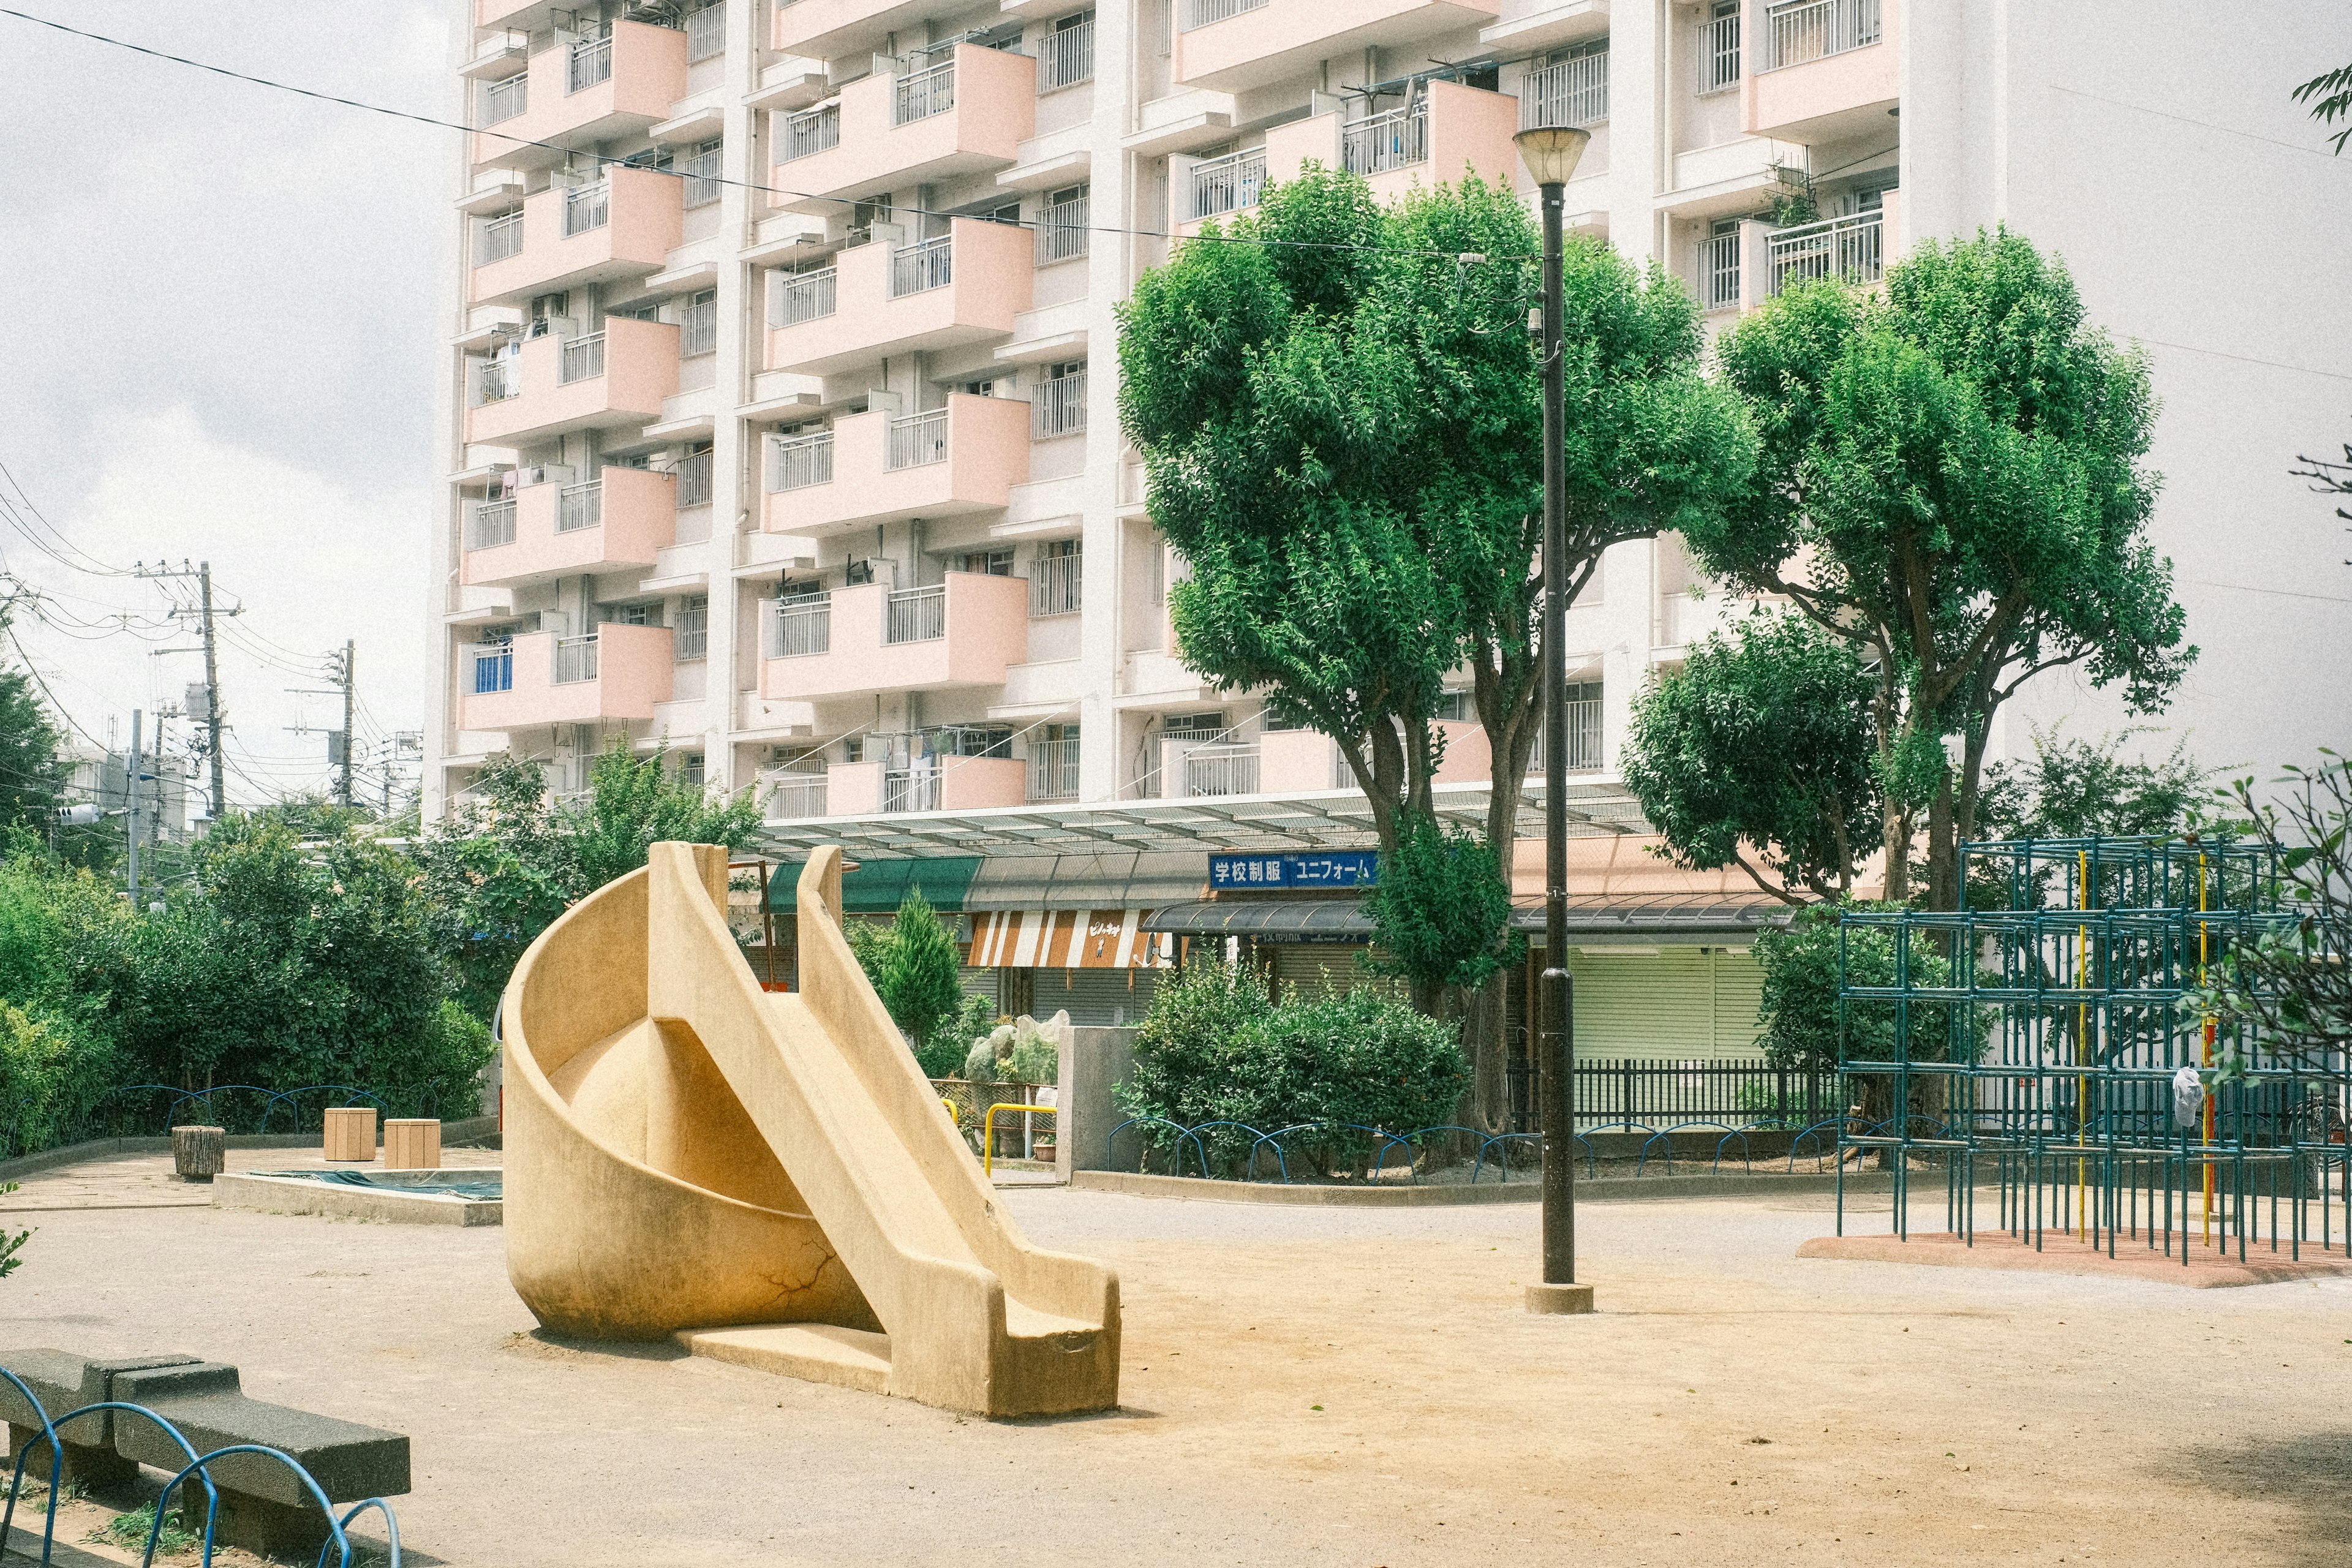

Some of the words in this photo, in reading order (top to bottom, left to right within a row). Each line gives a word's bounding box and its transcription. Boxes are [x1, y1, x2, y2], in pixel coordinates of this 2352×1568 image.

[1215, 861, 1281, 883] 学校制服
[1297, 859, 1370, 880] ユニフォーム
